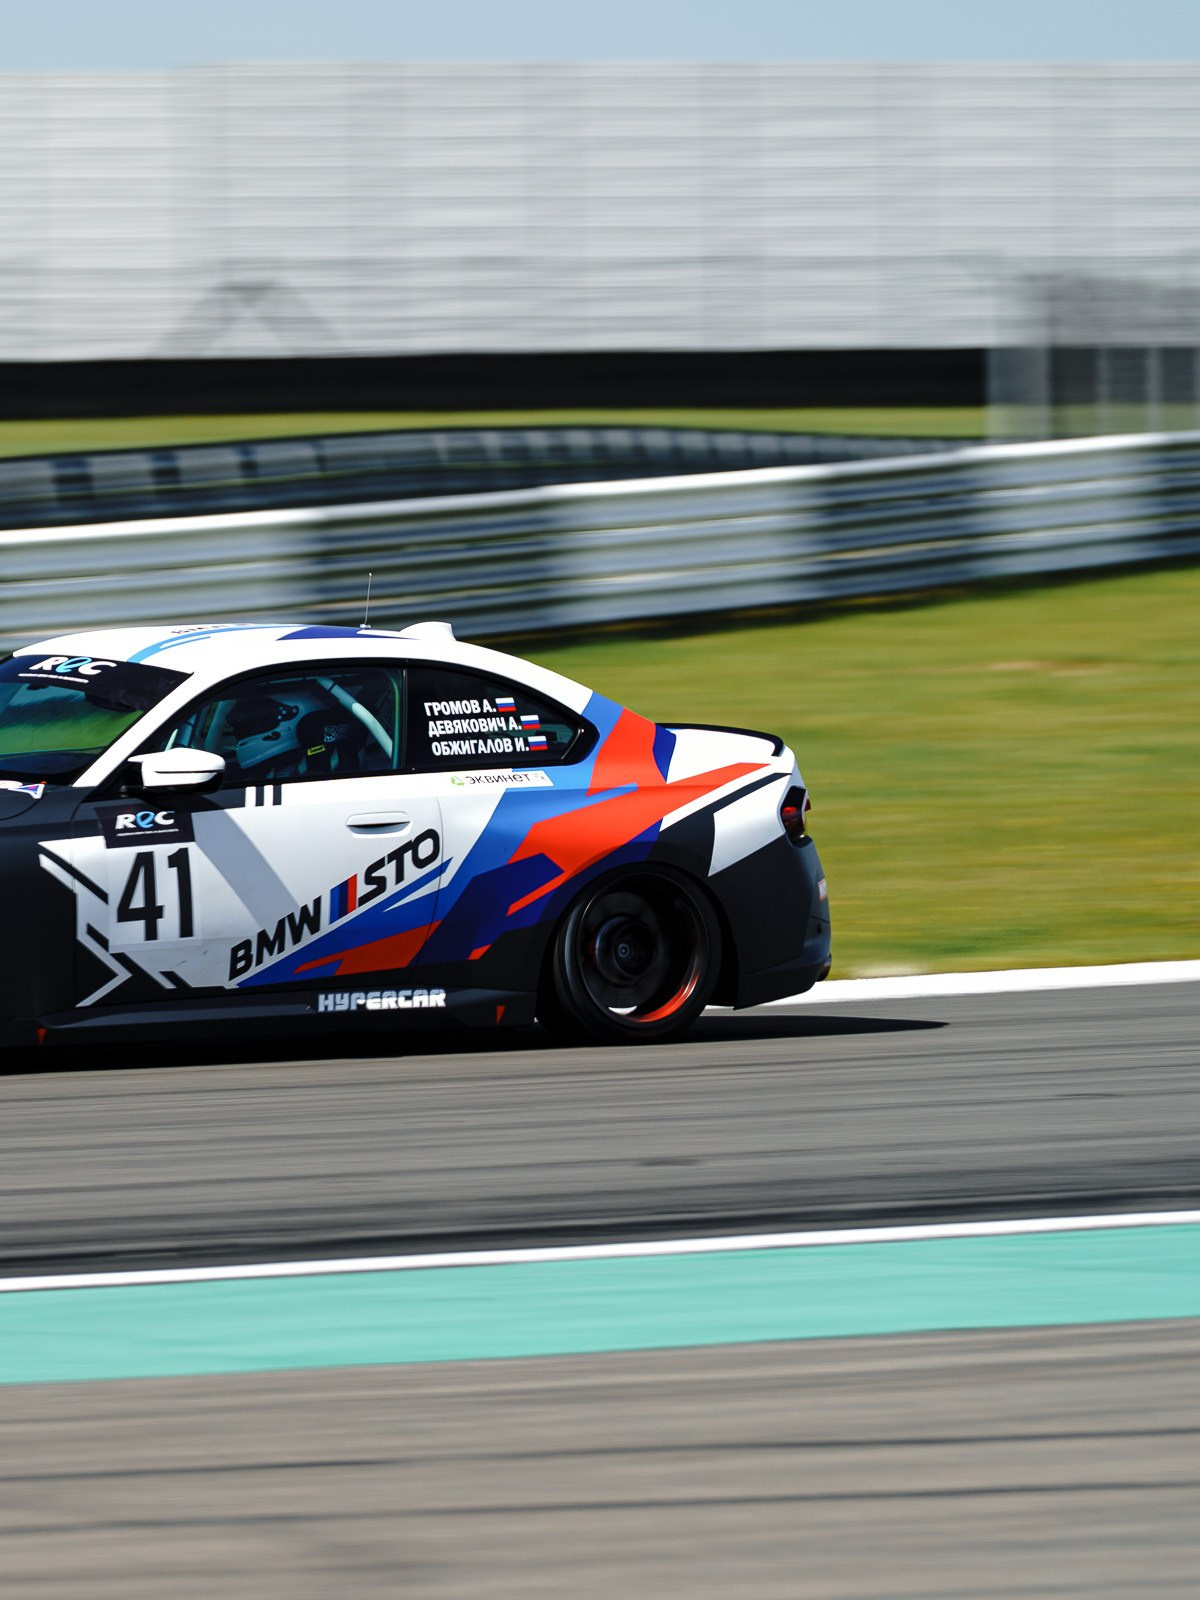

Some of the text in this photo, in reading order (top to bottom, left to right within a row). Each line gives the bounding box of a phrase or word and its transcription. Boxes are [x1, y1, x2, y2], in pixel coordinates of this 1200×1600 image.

[424, 698, 497, 717] ГРОМОВ А.
[428, 716, 522, 738] ДЕВЯКОВИЧ А.
[431, 736, 530, 756] ОБЖИГАЛОВ И.
[116, 847, 194, 942] 41
[228, 828, 440, 982] BMW STO
[318, 988, 447, 1012] HYPERCAR
